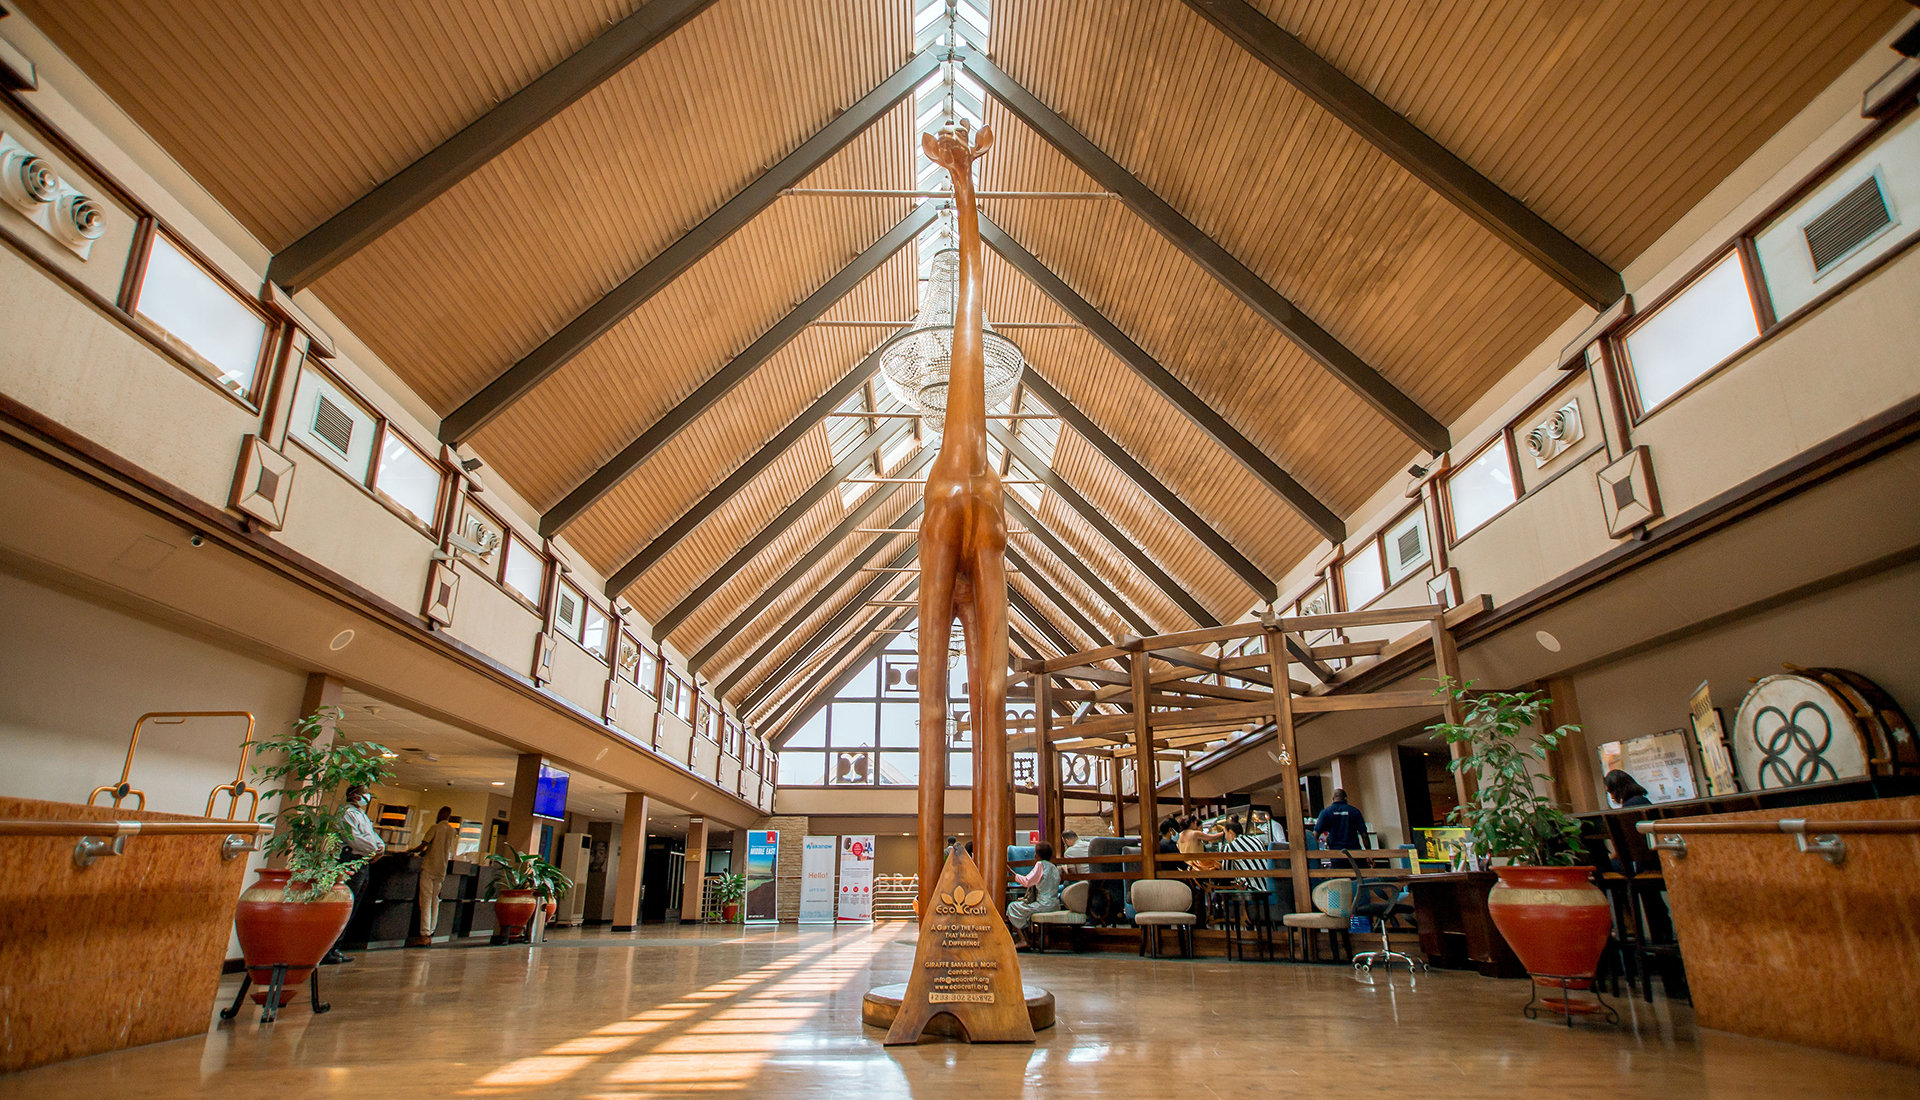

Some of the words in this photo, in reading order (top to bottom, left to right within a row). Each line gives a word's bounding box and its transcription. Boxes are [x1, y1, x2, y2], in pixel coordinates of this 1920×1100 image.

[935, 905, 956, 914] Eco
[963, 905, 987, 915] Craft
[924, 961, 949, 969] GIRAFFE
[934, 976, 990, 984] info@ecocraft.org
